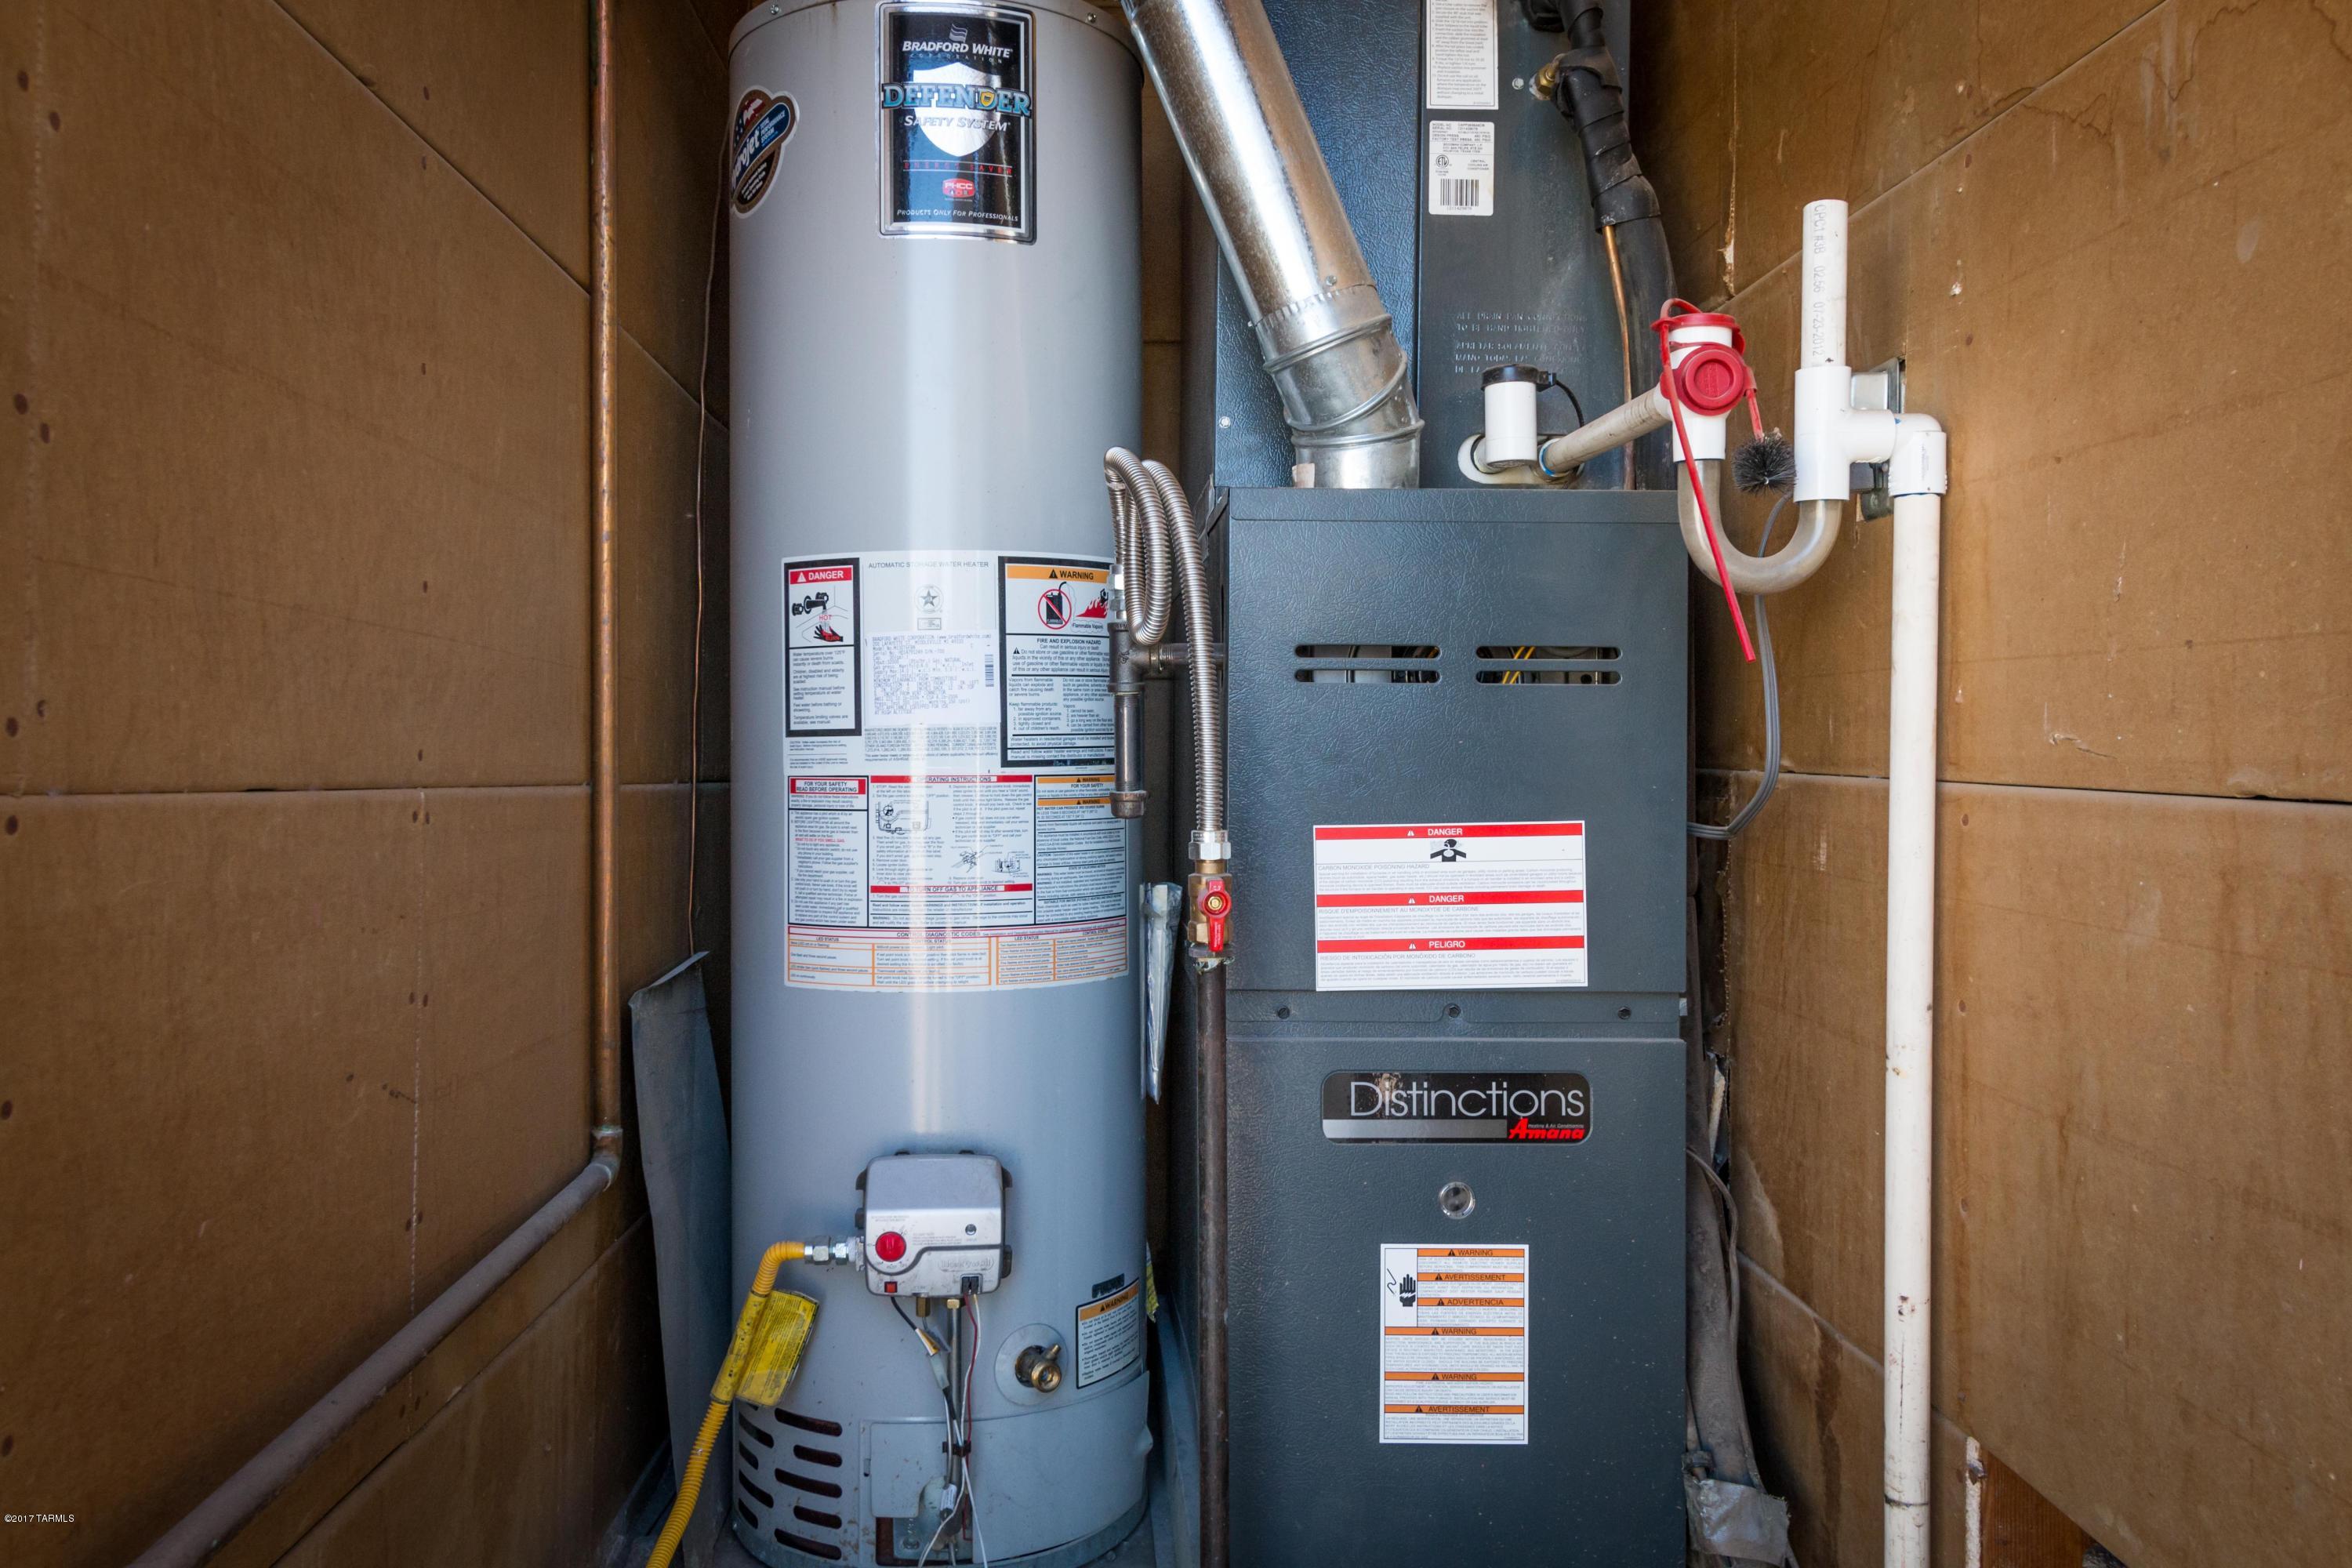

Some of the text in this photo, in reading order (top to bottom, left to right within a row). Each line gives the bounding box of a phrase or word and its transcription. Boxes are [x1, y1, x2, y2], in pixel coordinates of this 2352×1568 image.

[902, 41, 1011, 58] BRADFORD WHITE
[882, 82, 1032, 118] DEFENDER
[904, 116, 1007, 132] SAFETY SYSTEM
[970, 163, 1012, 174] SAVER
[968, 212, 1018, 221] PROFESSIONALS
[808, 571, 844, 579] DANGER
[1060, 571, 1094, 579] WARNING
[1428, 827, 1463, 837] DANGER
[1428, 895, 1465, 904] DANGER
[1428, 940, 1465, 949] PELIGRO
[1350, 1081, 1585, 1117] Distinctions
[1508, 1117, 1585, 1139] Amana
[1104, 1292, 1129, 1309] WARNING
